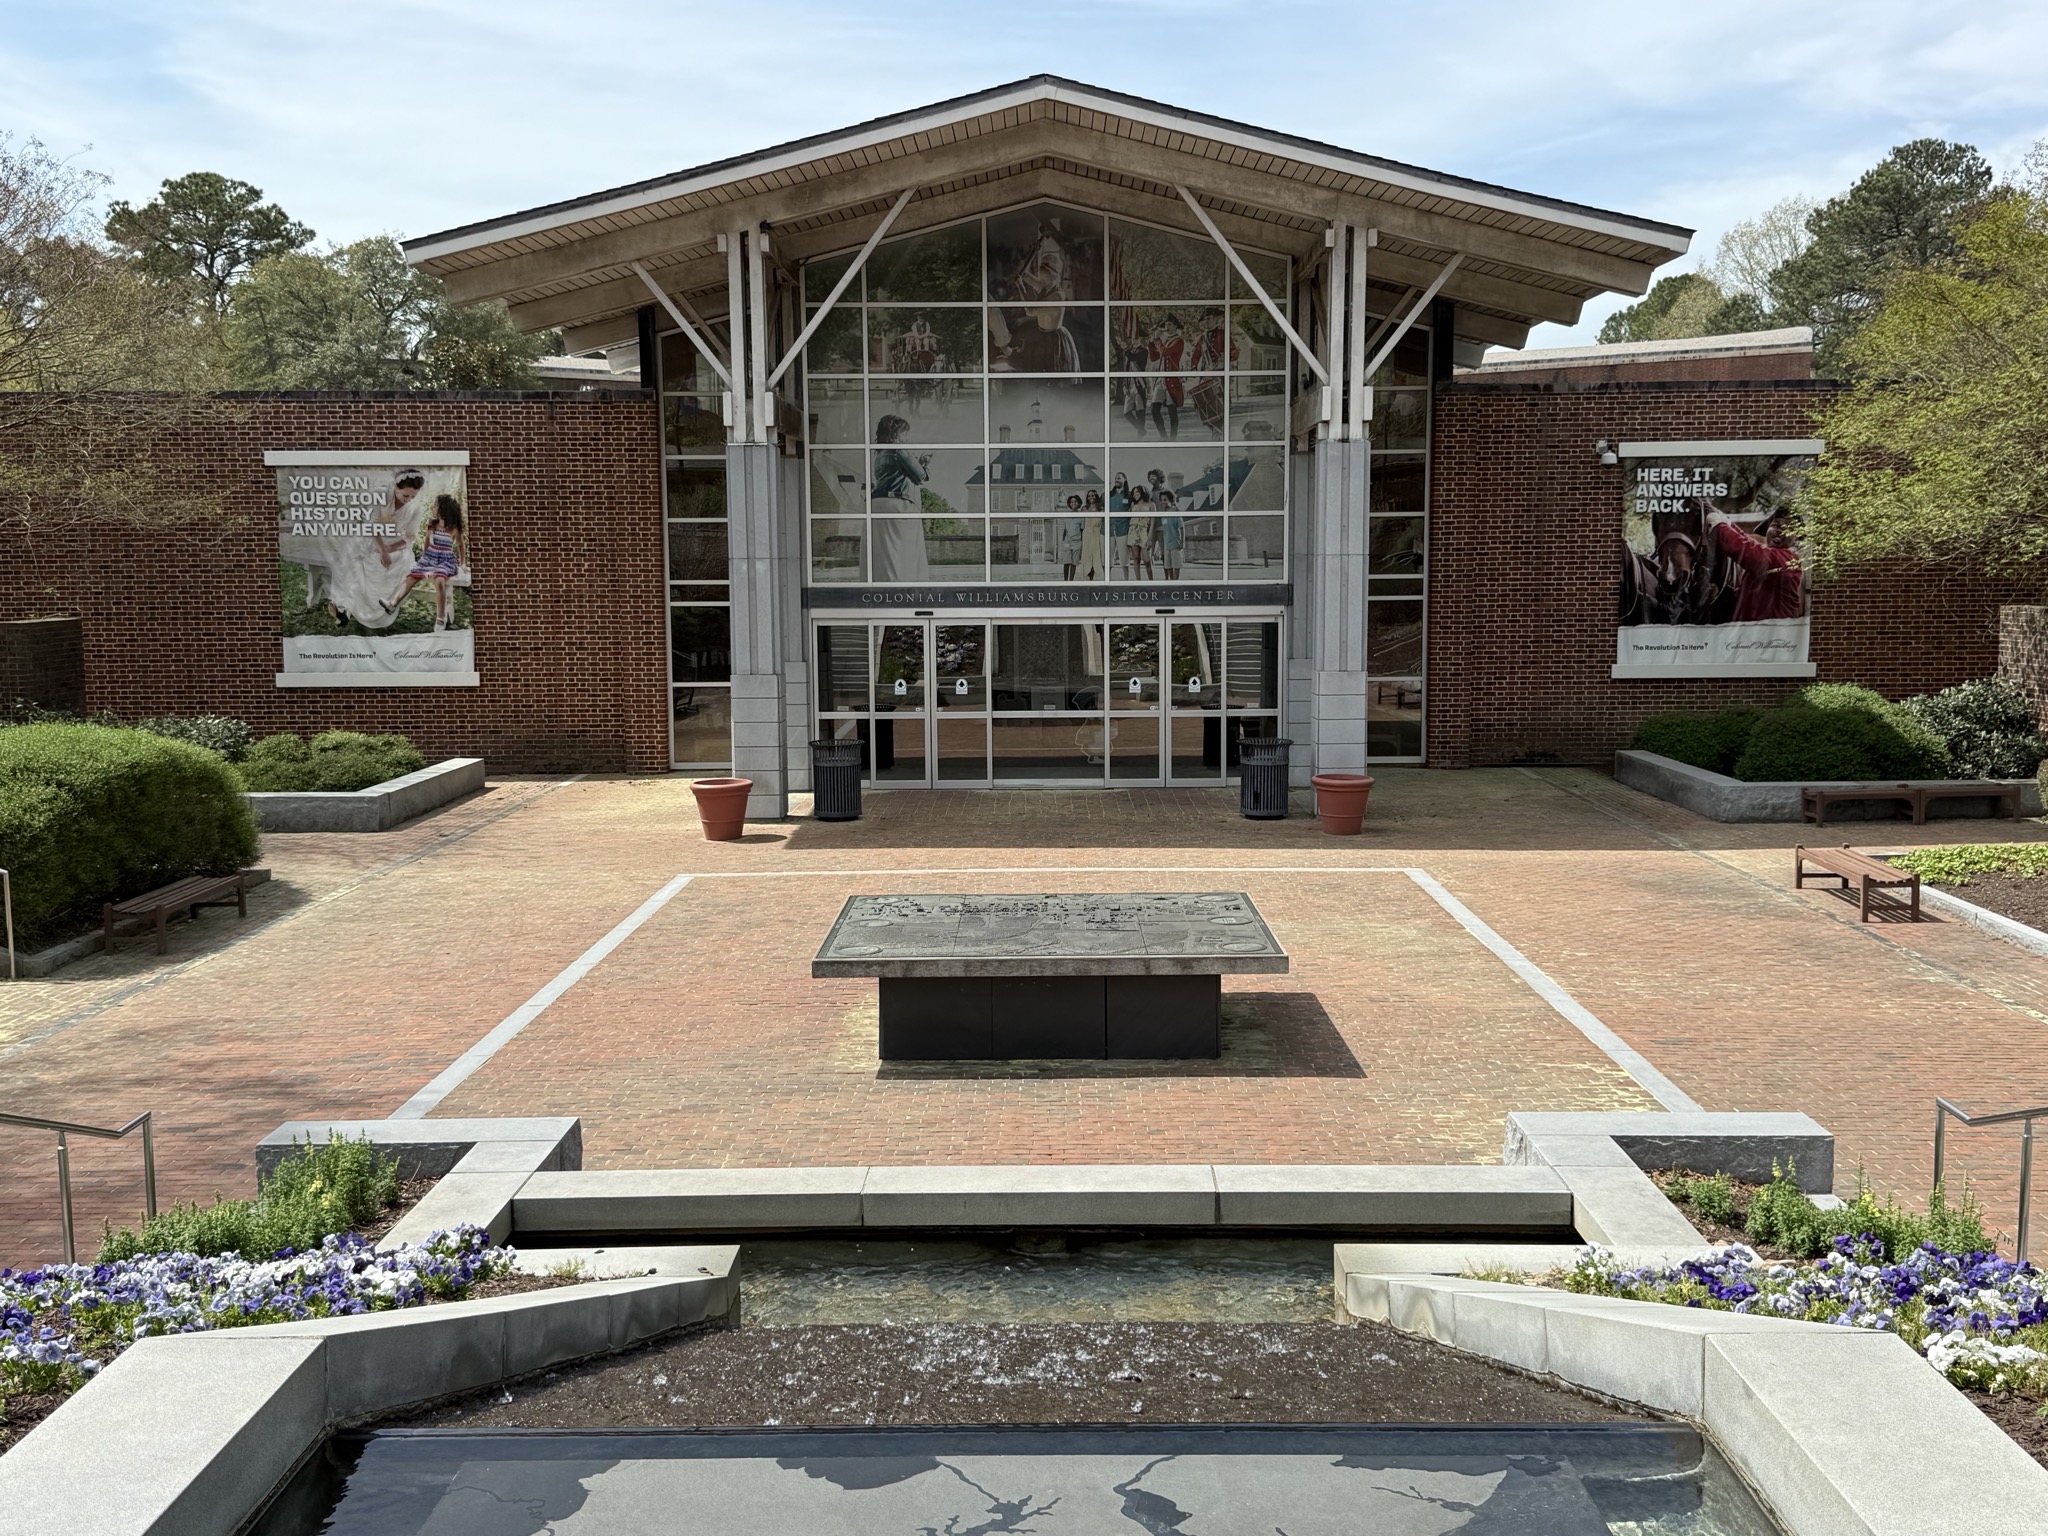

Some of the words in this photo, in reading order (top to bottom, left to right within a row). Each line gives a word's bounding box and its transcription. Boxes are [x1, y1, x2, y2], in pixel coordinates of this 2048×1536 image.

[1636, 467, 1689, 483] HERE,
[1692, 467, 1714, 482] IT
[288, 476, 326, 490] YOU
[329, 476, 369, 490] CAN
[1636, 483, 1728, 497] ANSWERS
[289, 491, 387, 506] QUESTION
[1635, 499, 1690, 513] BACK.
[290, 507, 374, 521] HISTORY
[291, 523, 401, 537] ANYWHERE.
[862, 593, 945, 603] COLONIAL
[956, 592, 1080, 602] WILLIAMSBURG
[1092, 591, 1159, 601] VISITOR
[1170, 591, 1236, 601] CENTER
